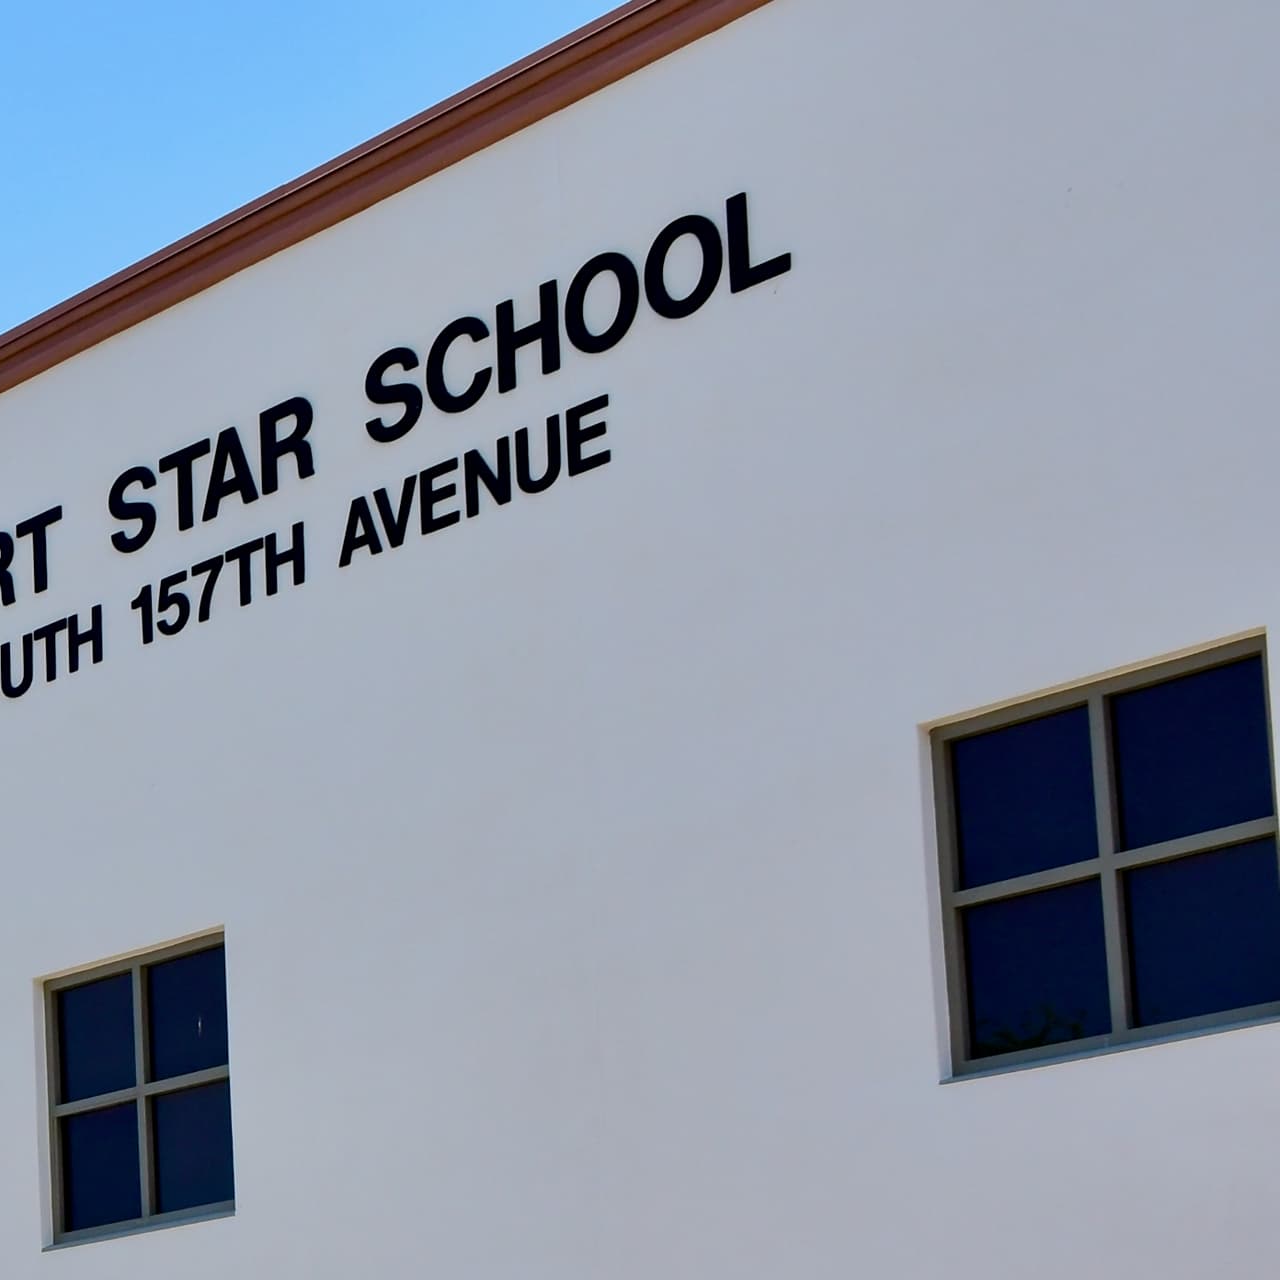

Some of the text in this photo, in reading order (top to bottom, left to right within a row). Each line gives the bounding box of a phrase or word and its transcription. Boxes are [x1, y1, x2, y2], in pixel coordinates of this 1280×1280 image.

[108, 396, 315, 554] STAR
[365, 191, 792, 443] SCHOOL
[131, 521, 305, 645] 157TH
[339, 394, 611, 568] AVENUE
